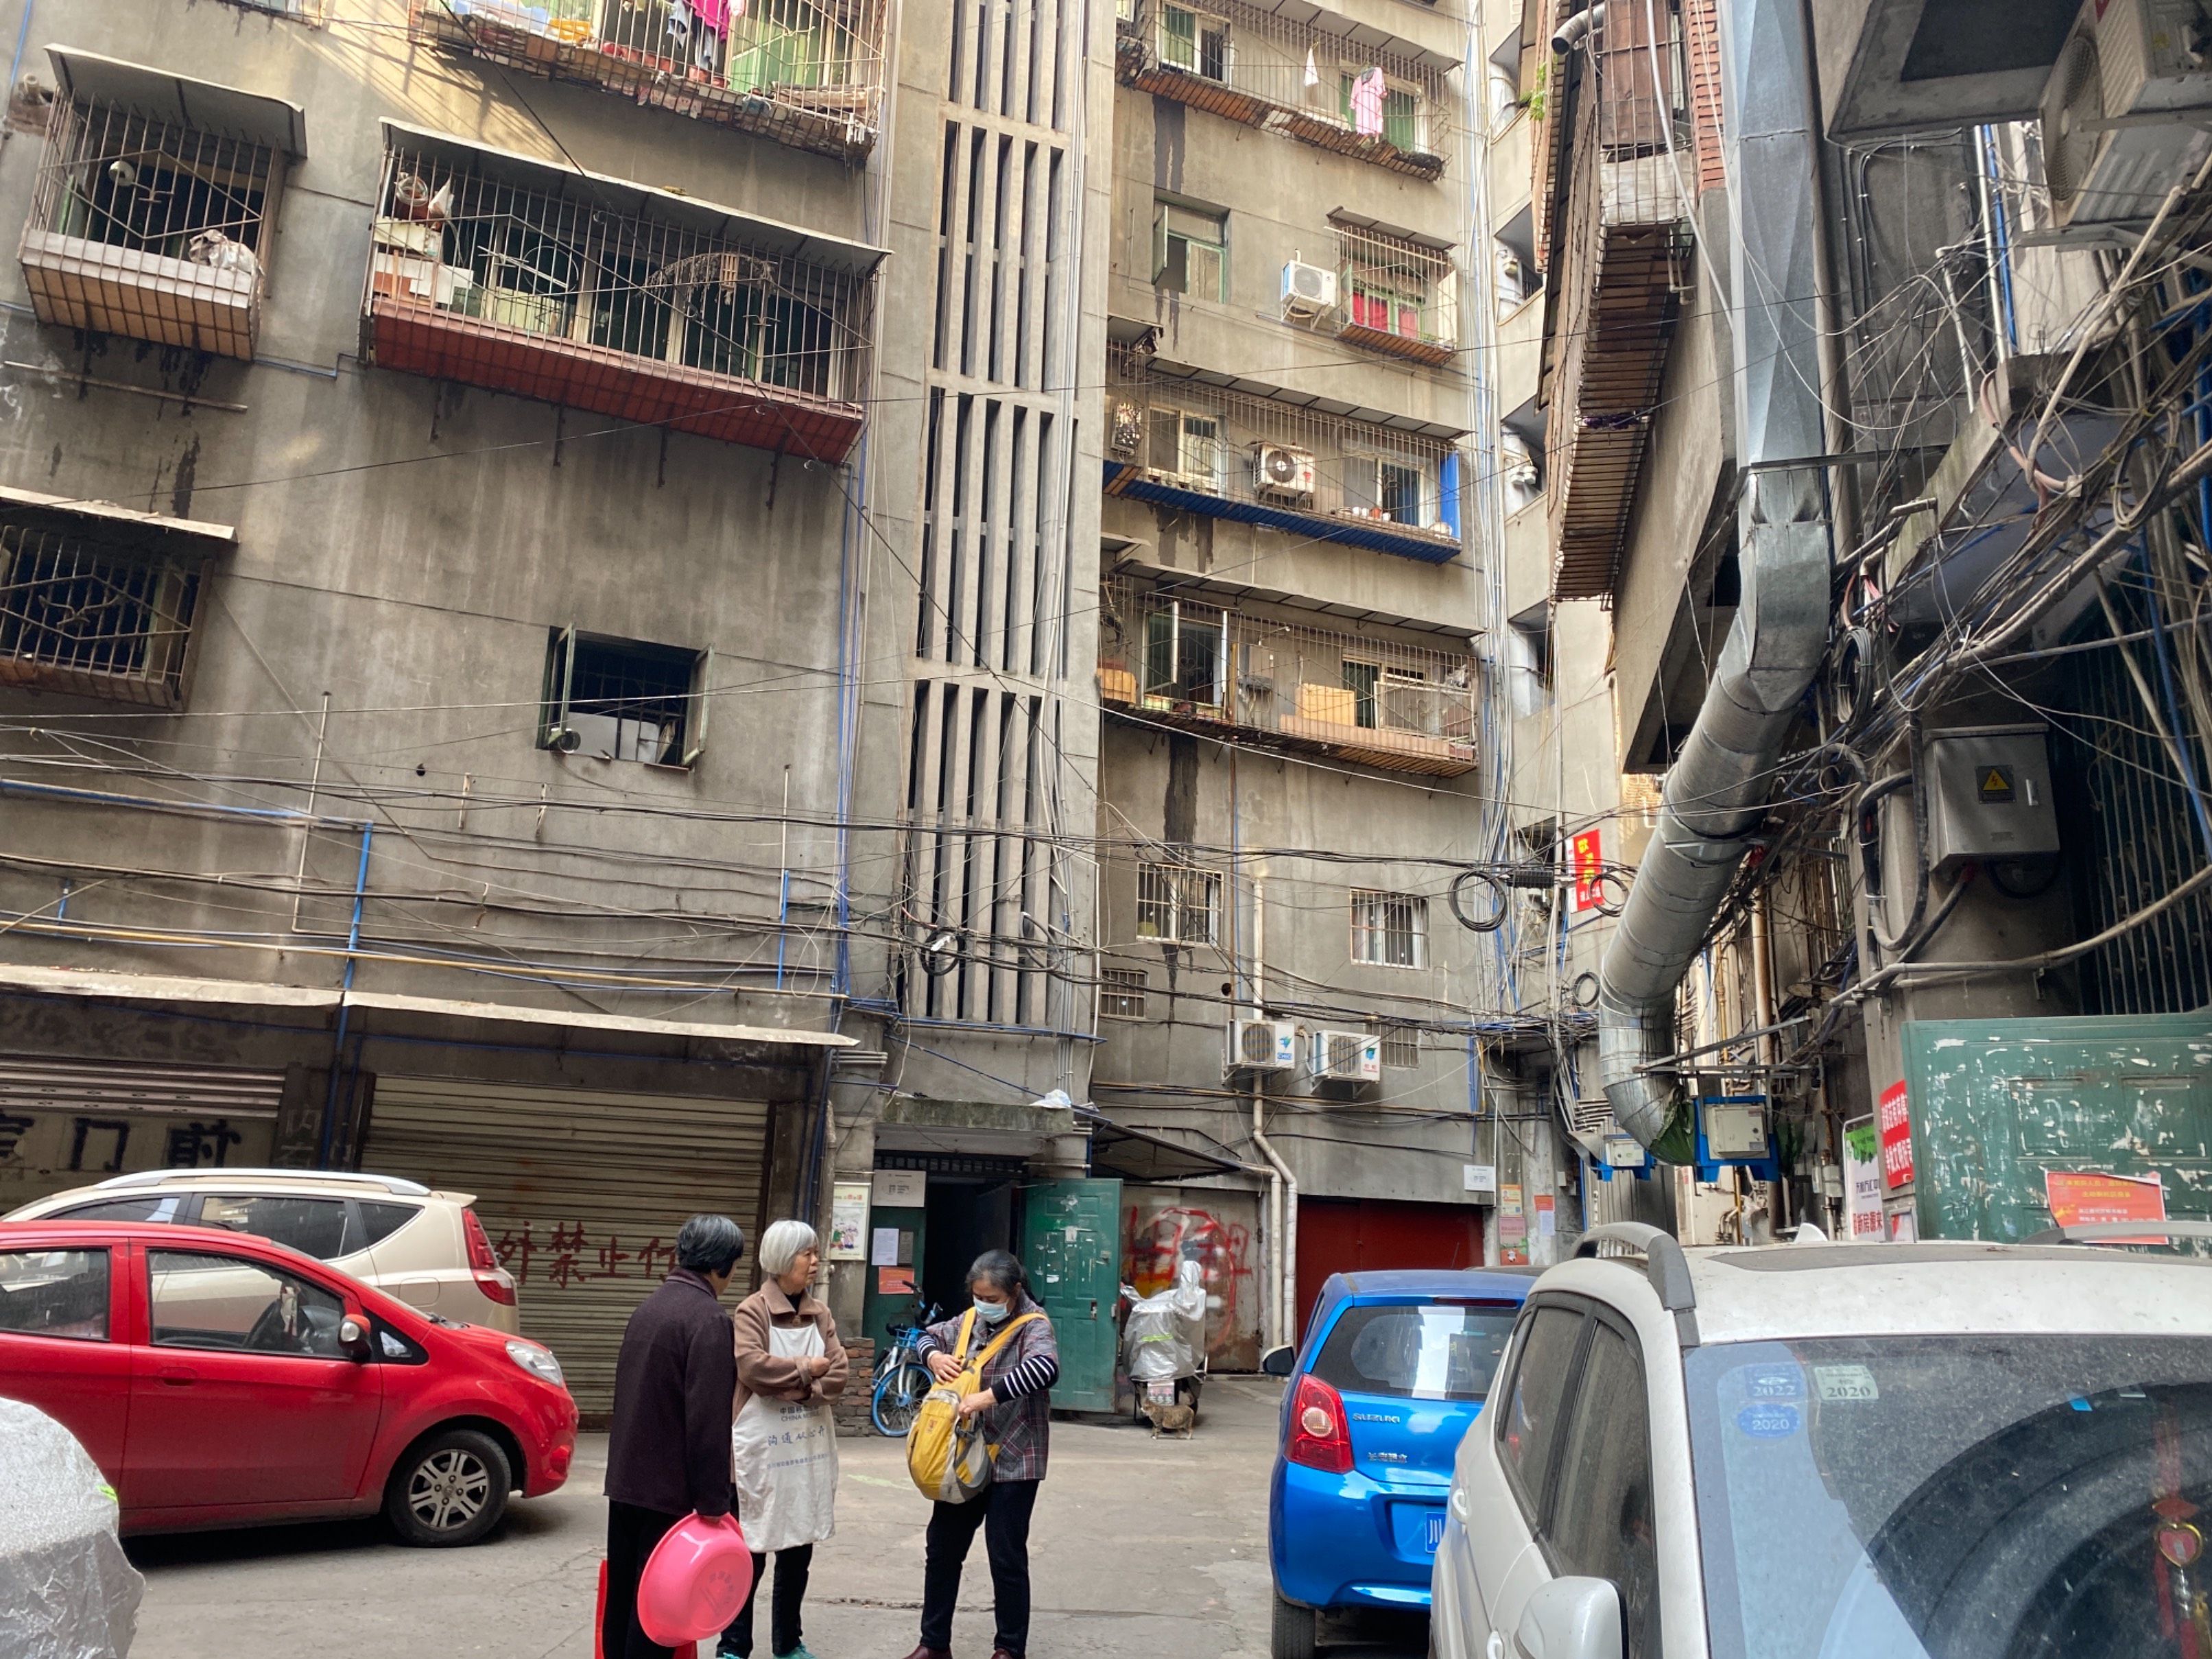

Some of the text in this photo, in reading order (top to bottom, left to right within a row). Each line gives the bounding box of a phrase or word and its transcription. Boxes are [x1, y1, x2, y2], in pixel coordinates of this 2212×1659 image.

[1752, 1385, 1797, 1397] 2022
[1825, 1385, 1872, 1398] 2020
[1352, 1412, 1401, 1424] SUZUKI
[1752, 1419, 1790, 1431] 2020
[1429, 1518, 1443, 1544] 川
